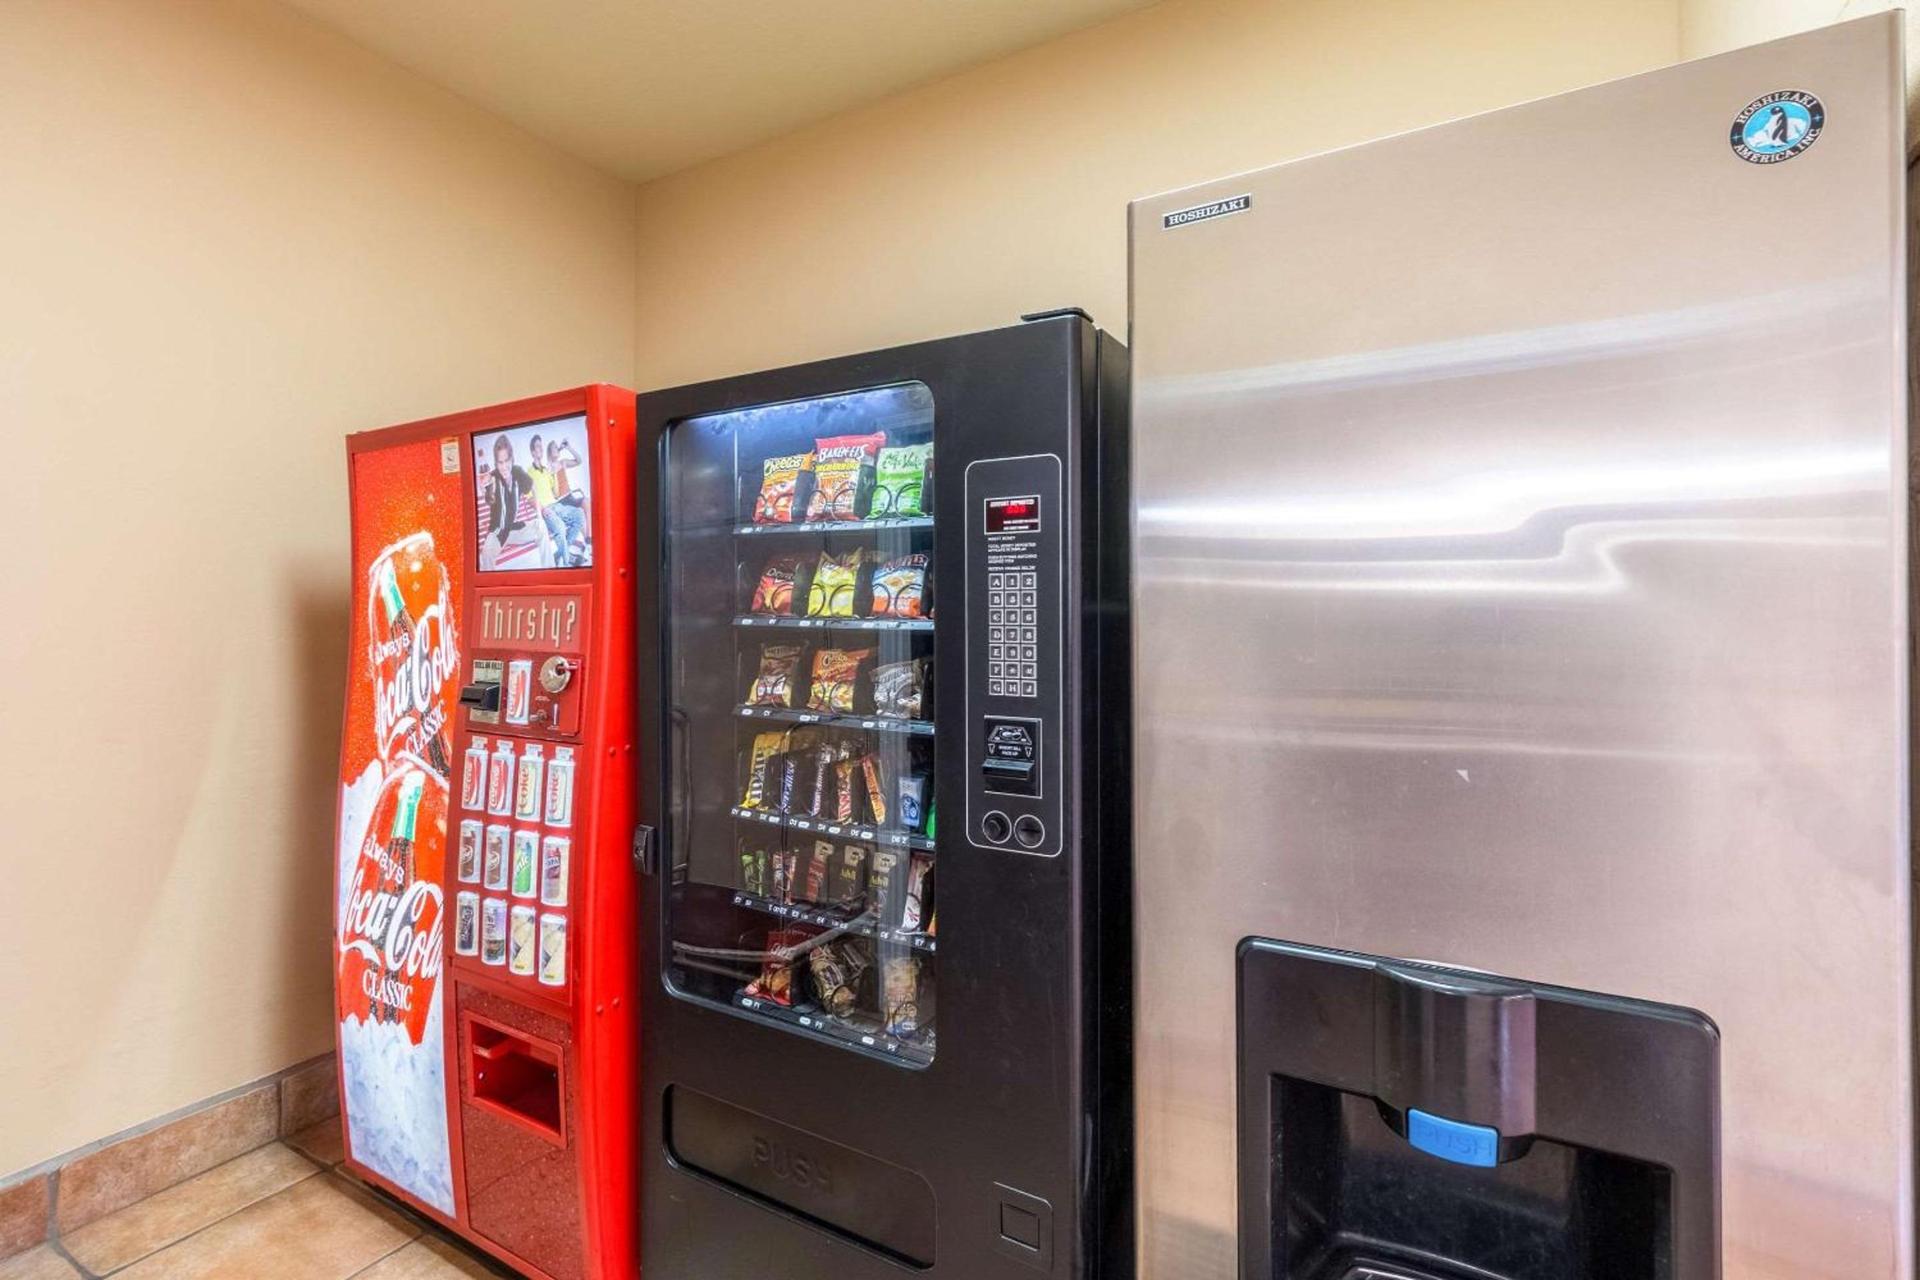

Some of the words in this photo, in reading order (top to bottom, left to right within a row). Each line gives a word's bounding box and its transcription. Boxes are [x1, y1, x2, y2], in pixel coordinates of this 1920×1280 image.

[1736, 92, 1817, 123] HOSHIZAKI
[1168, 198, 1246, 225] HOSHIZAKI
[483, 600, 576, 648] Thirsty?
[364, 833, 405, 884] always
[362, 968, 413, 1011] CLASSIC
[751, 1137, 834, 1193] PUSH
